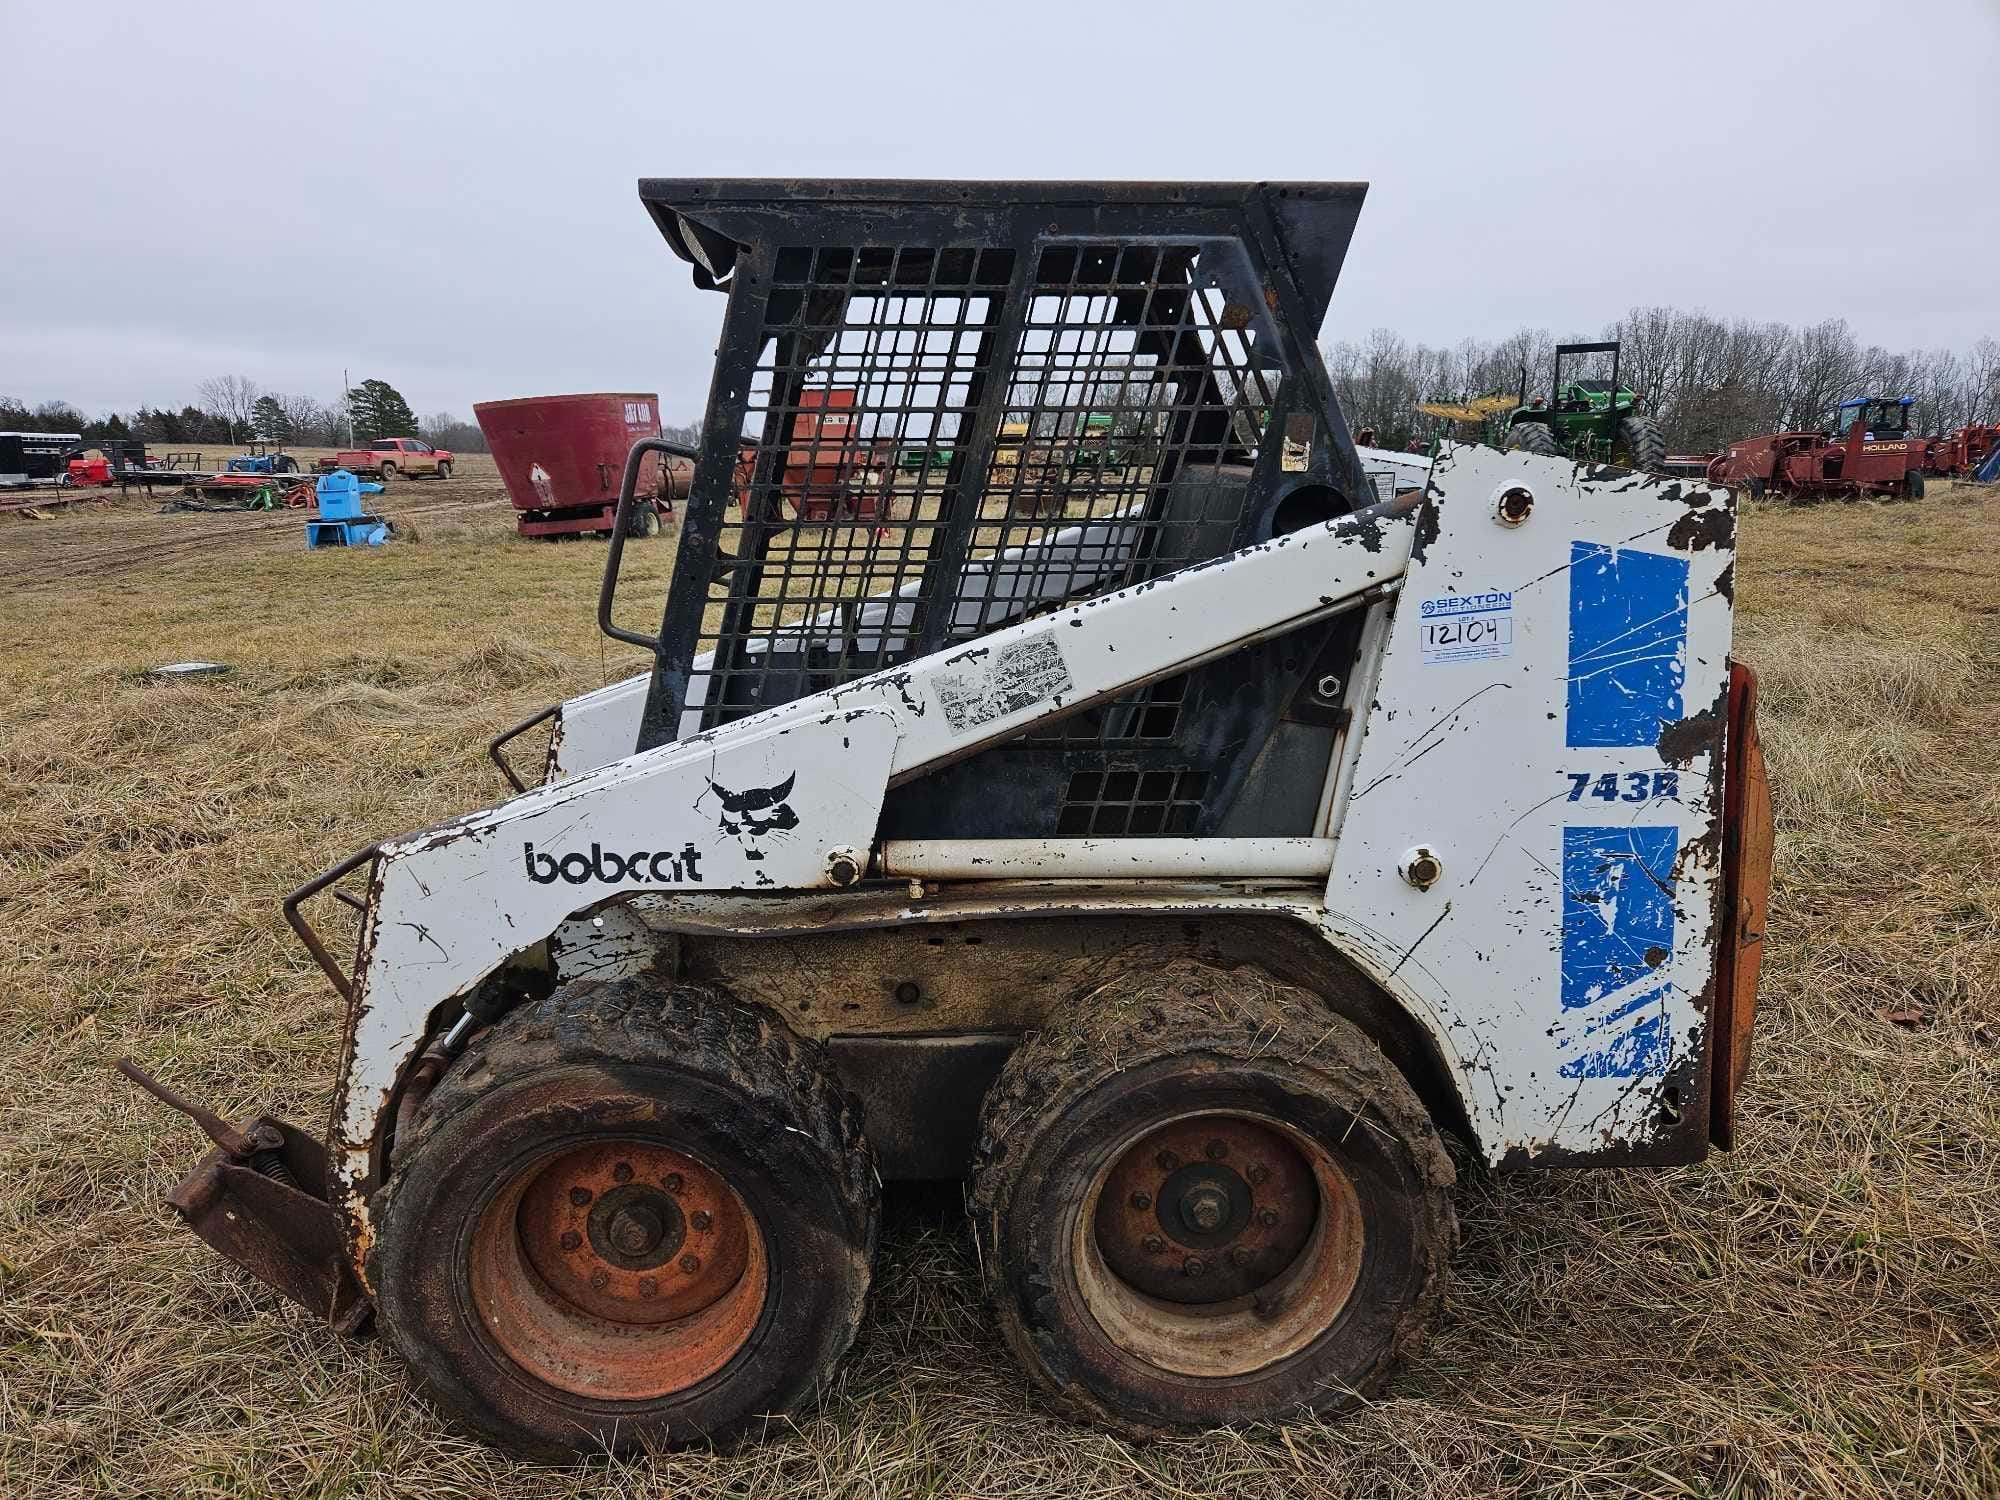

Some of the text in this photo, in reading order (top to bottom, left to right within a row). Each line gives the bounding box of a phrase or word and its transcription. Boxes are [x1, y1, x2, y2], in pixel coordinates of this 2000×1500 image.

[1862, 443, 1908, 452] HOLLAND
[1436, 592, 1512, 609] SEXTON
[1437, 602, 1512, 614] AUCTIONEERS
[1429, 619, 1497, 645] 12104
[1567, 772, 1680, 803] 743B
[523, 842, 703, 885] bobcat
